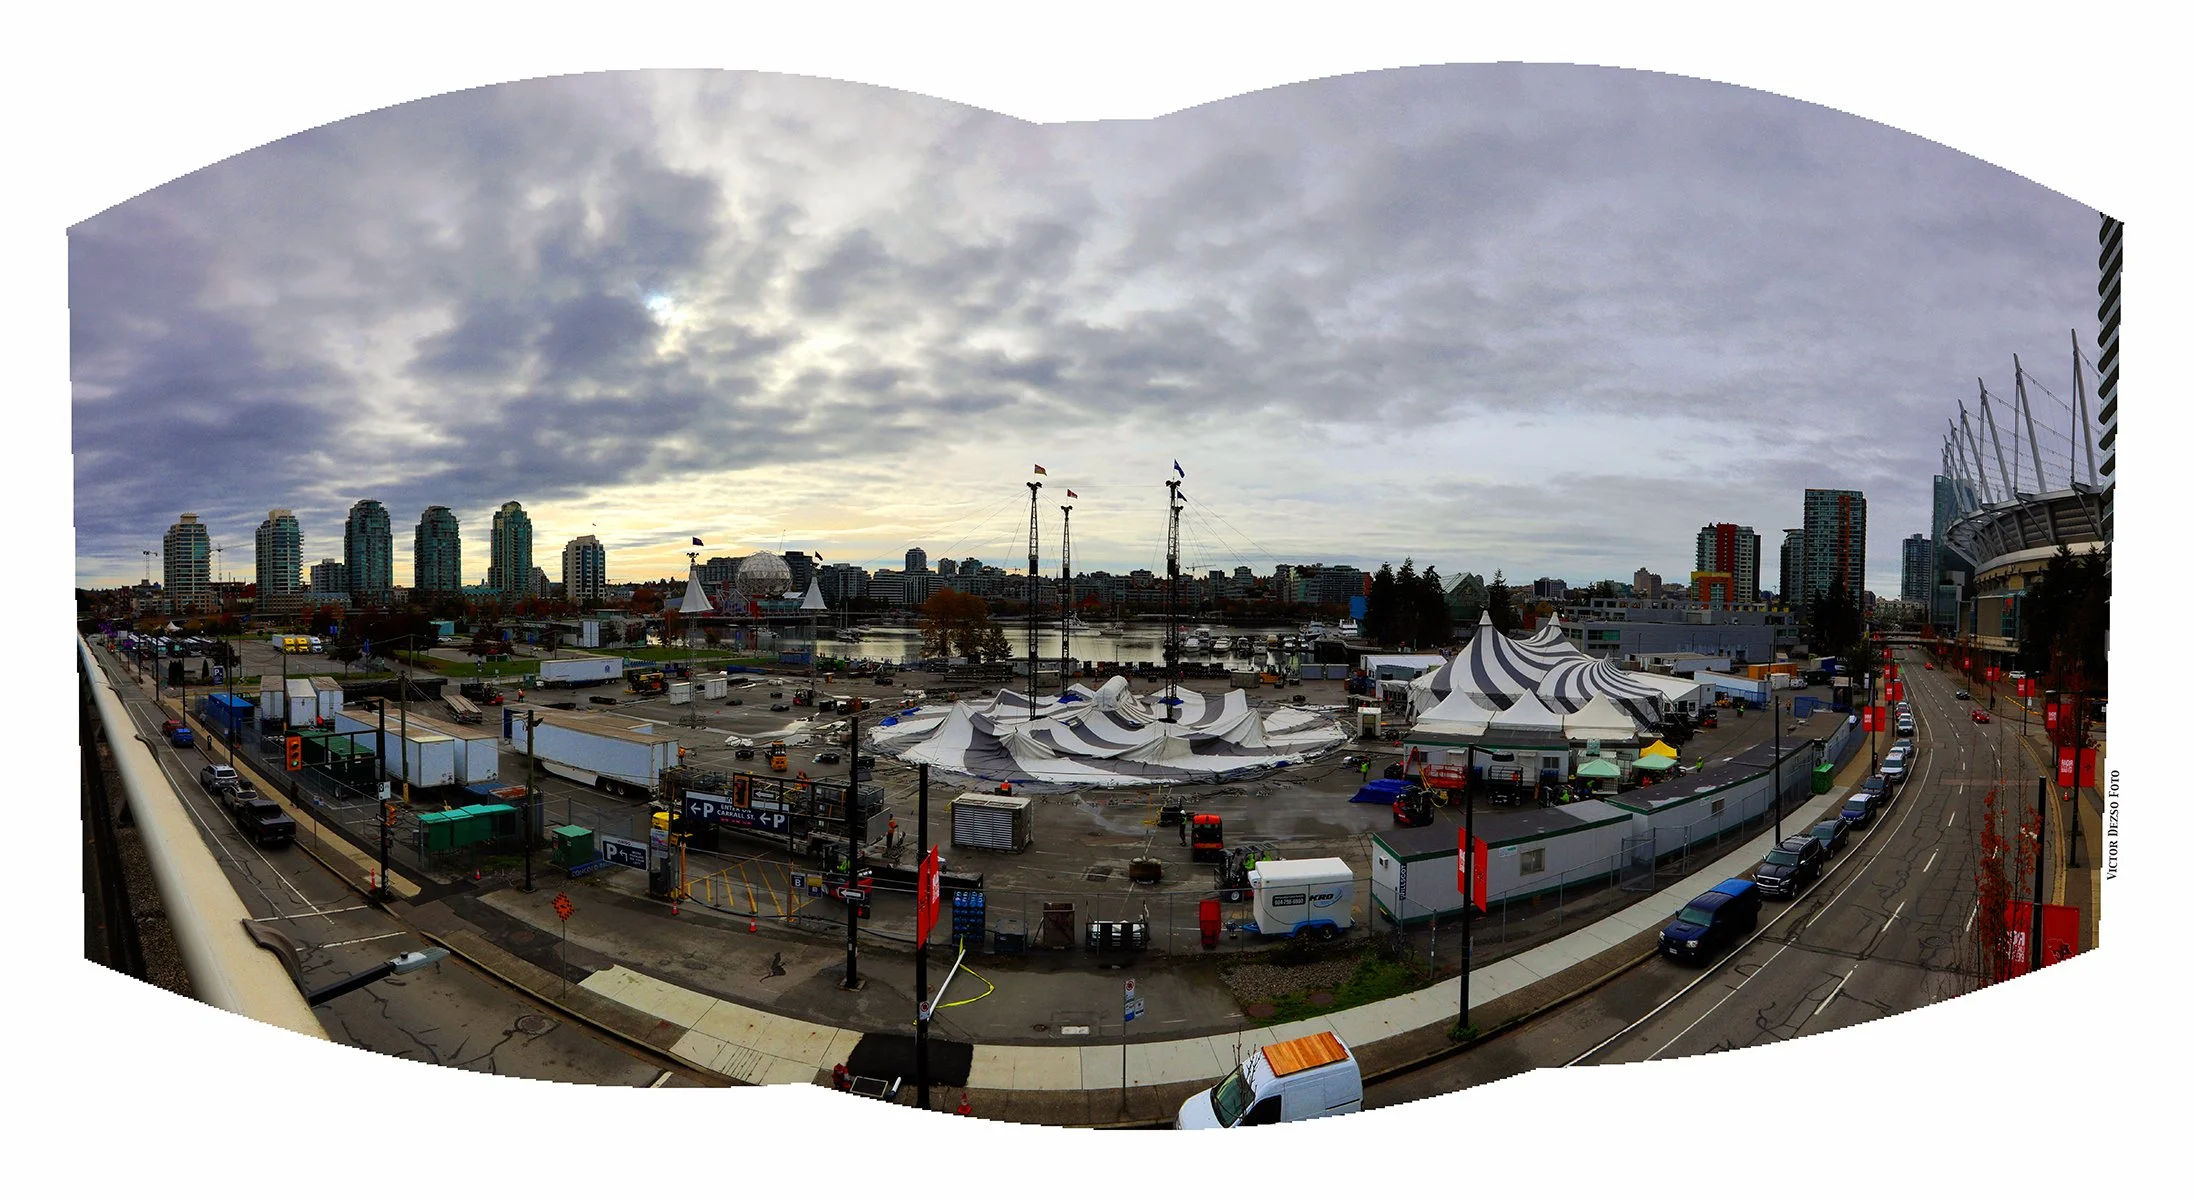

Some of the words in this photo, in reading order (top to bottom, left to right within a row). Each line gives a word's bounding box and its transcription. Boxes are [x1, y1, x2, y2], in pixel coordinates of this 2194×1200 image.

[703, 802, 714, 818] P
[716, 809, 745, 820] CARRALL
[720, 803, 740, 812] ENTER
[773, 813, 785, 828] P
[606, 842, 618, 861] P
[794, 879, 801, 887] B
[1399, 864, 1407, 900] WILLSCOT
